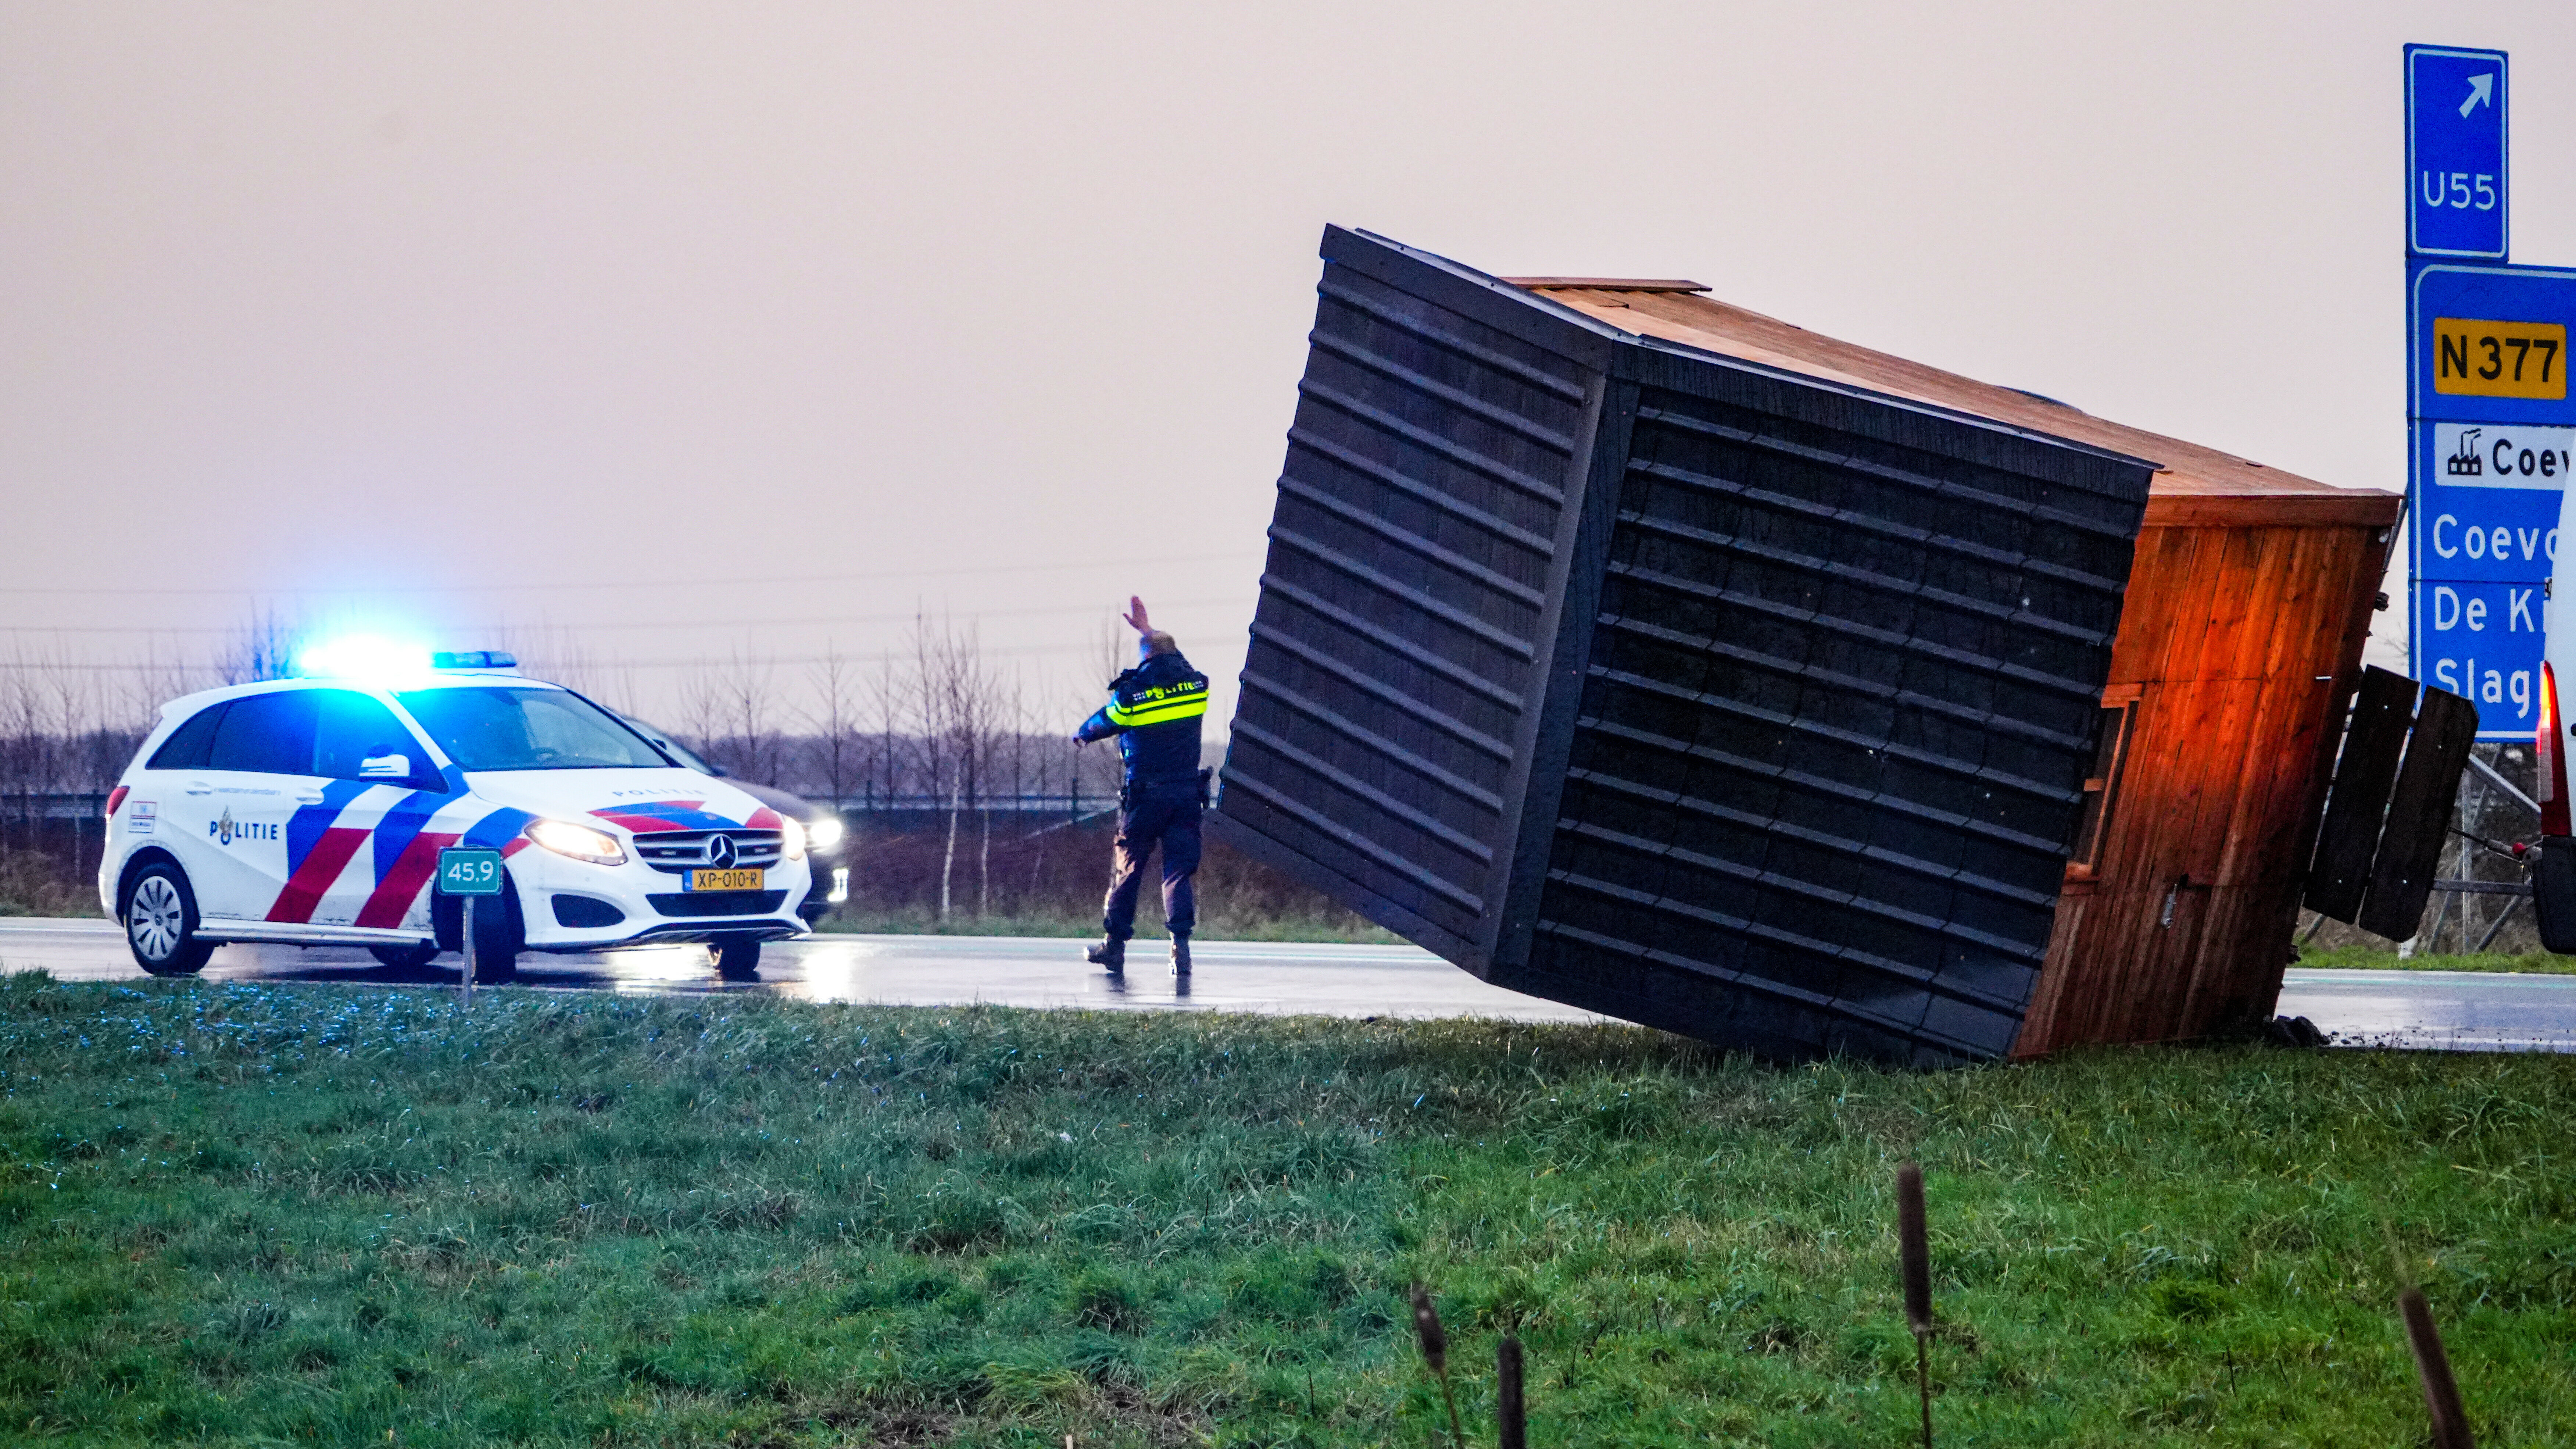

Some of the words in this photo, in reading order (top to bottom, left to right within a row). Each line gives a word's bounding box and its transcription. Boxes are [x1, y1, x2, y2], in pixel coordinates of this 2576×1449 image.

[2424, 171, 2496, 211] U55
[2442, 334, 2558, 383] N377
[2434, 586, 2487, 631] De
[2436, 658, 2544, 719] Slag
[210, 821, 278, 845] POLITIE
[698, 872, 757, 888] XP-010-R
